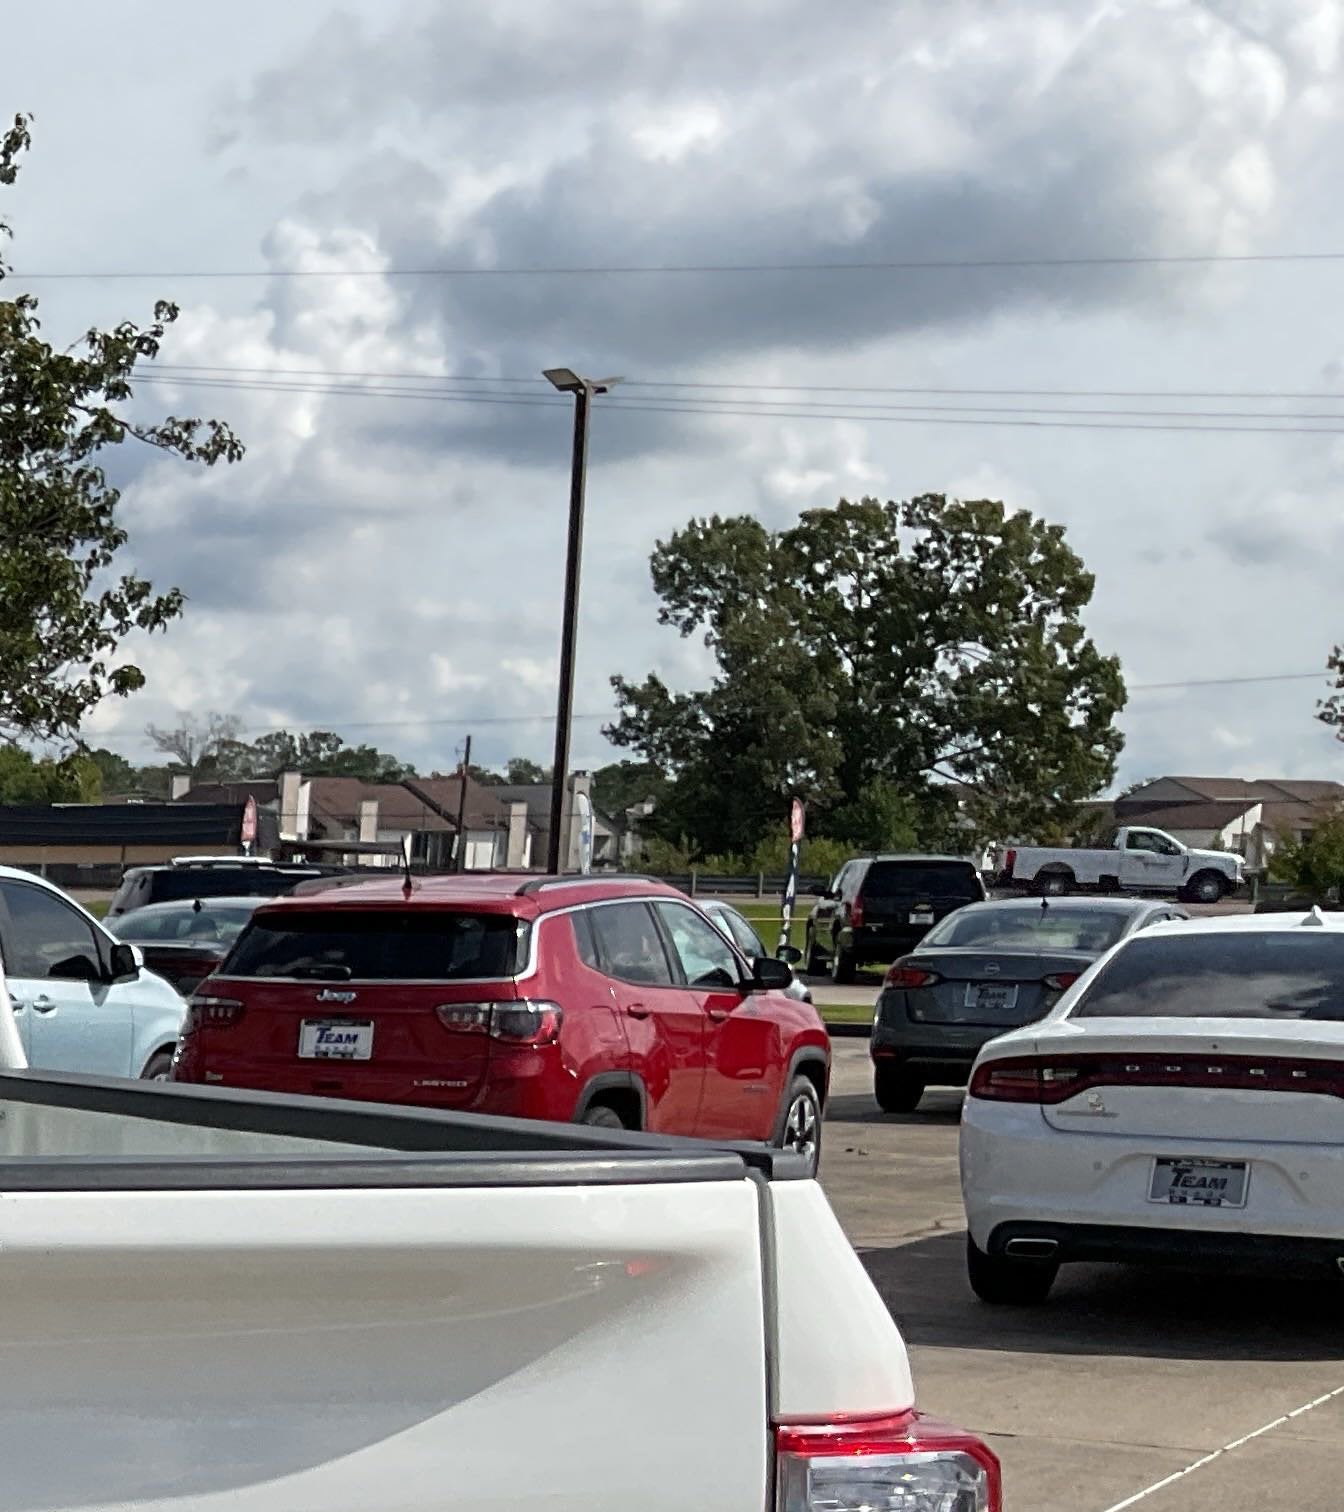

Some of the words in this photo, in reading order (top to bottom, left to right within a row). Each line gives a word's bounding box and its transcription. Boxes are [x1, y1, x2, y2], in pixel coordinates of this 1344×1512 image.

[316, 988, 357, 1004] Jeep
[316, 1027, 358, 1044] TEAM
[1172, 1167, 1228, 1190] TEAM
